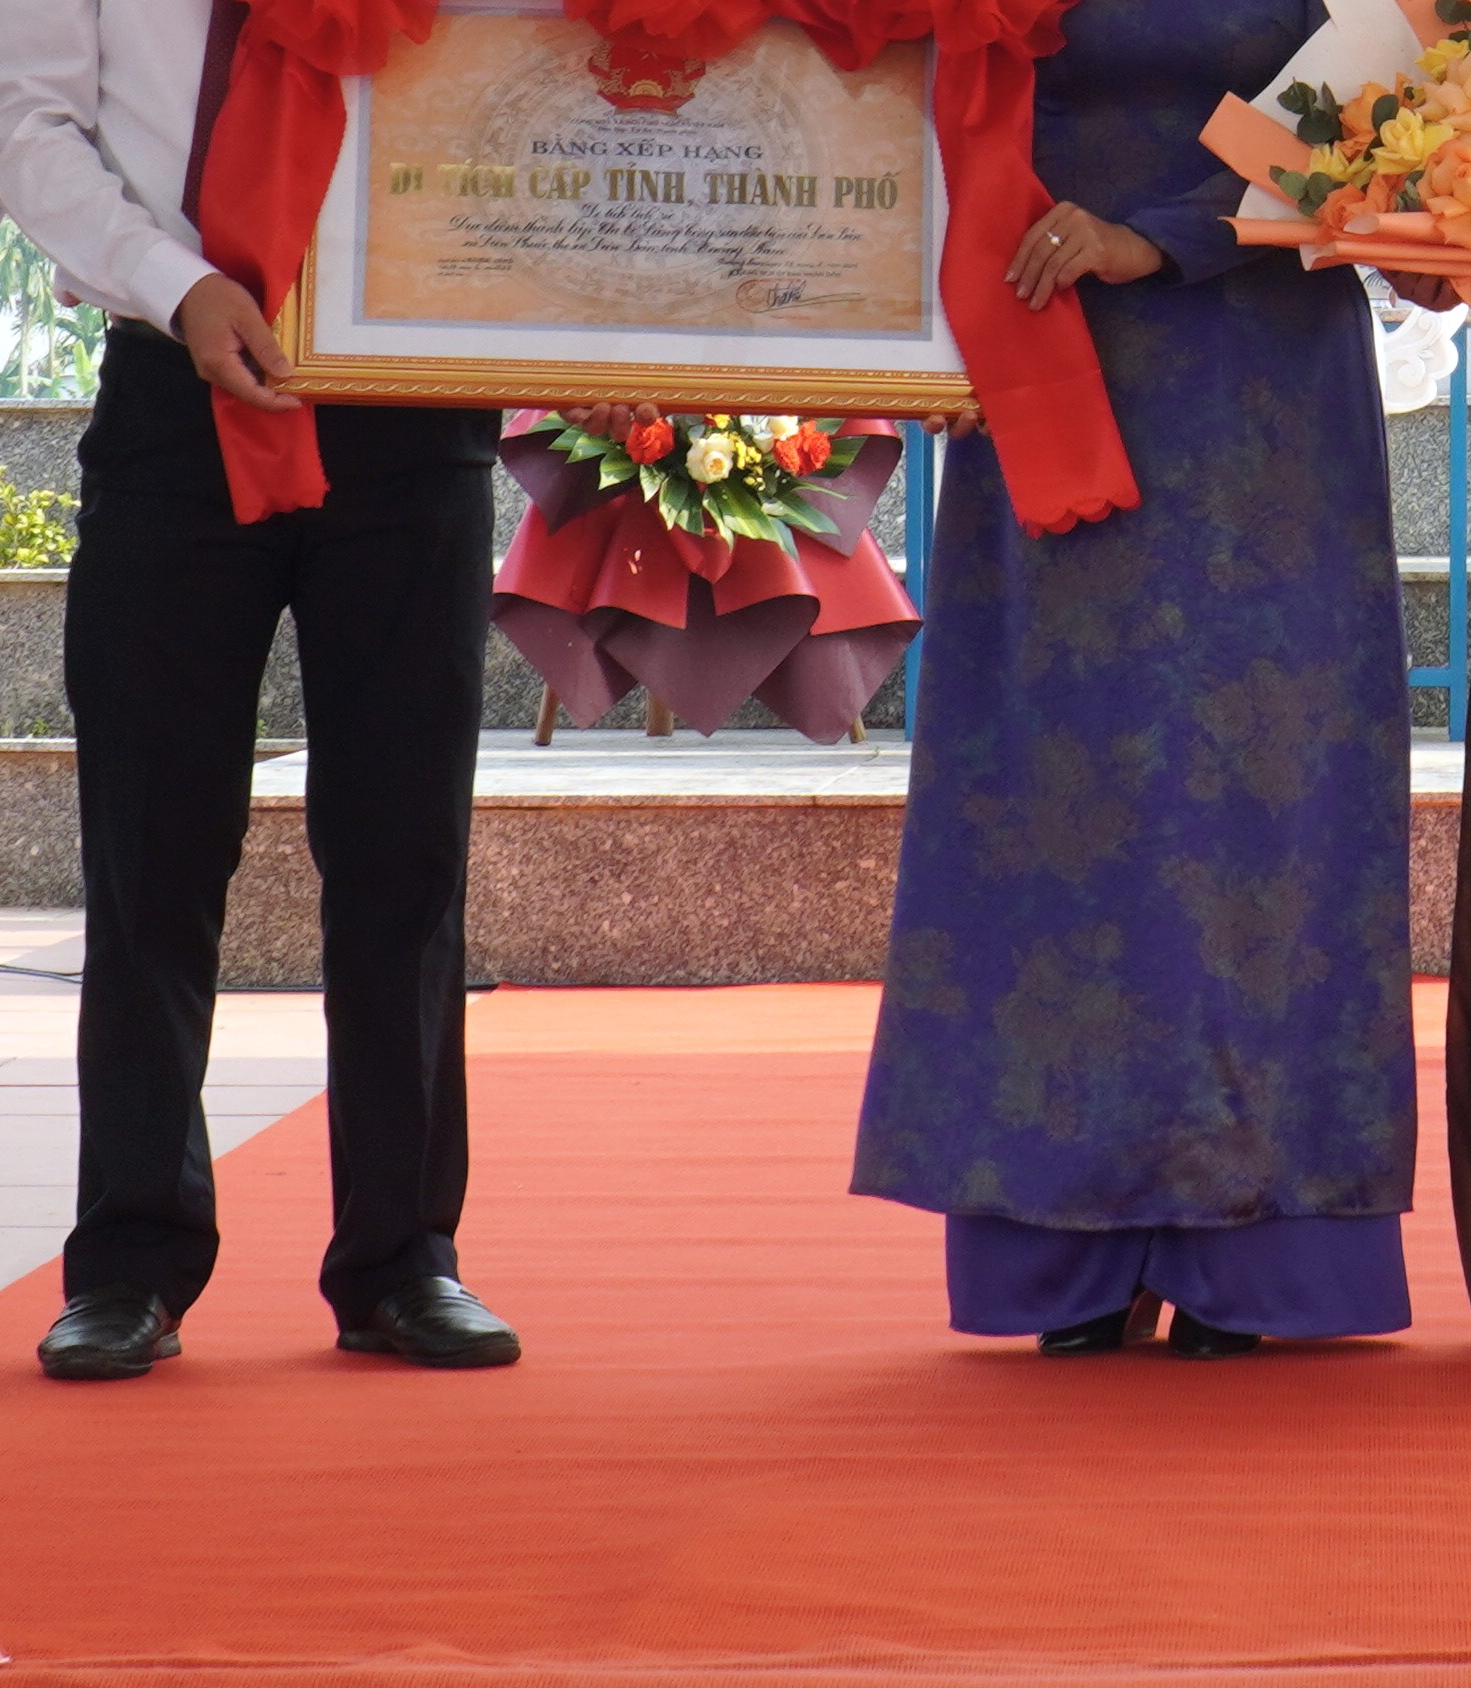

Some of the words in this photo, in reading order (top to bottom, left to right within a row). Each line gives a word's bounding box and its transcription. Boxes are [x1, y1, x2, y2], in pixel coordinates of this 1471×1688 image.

[616, 137, 673, 157] XẾP
[683, 145, 763, 163] HẠNG
[704, 167, 818, 207] THÀNH
[833, 171, 901, 209] PHỐ
